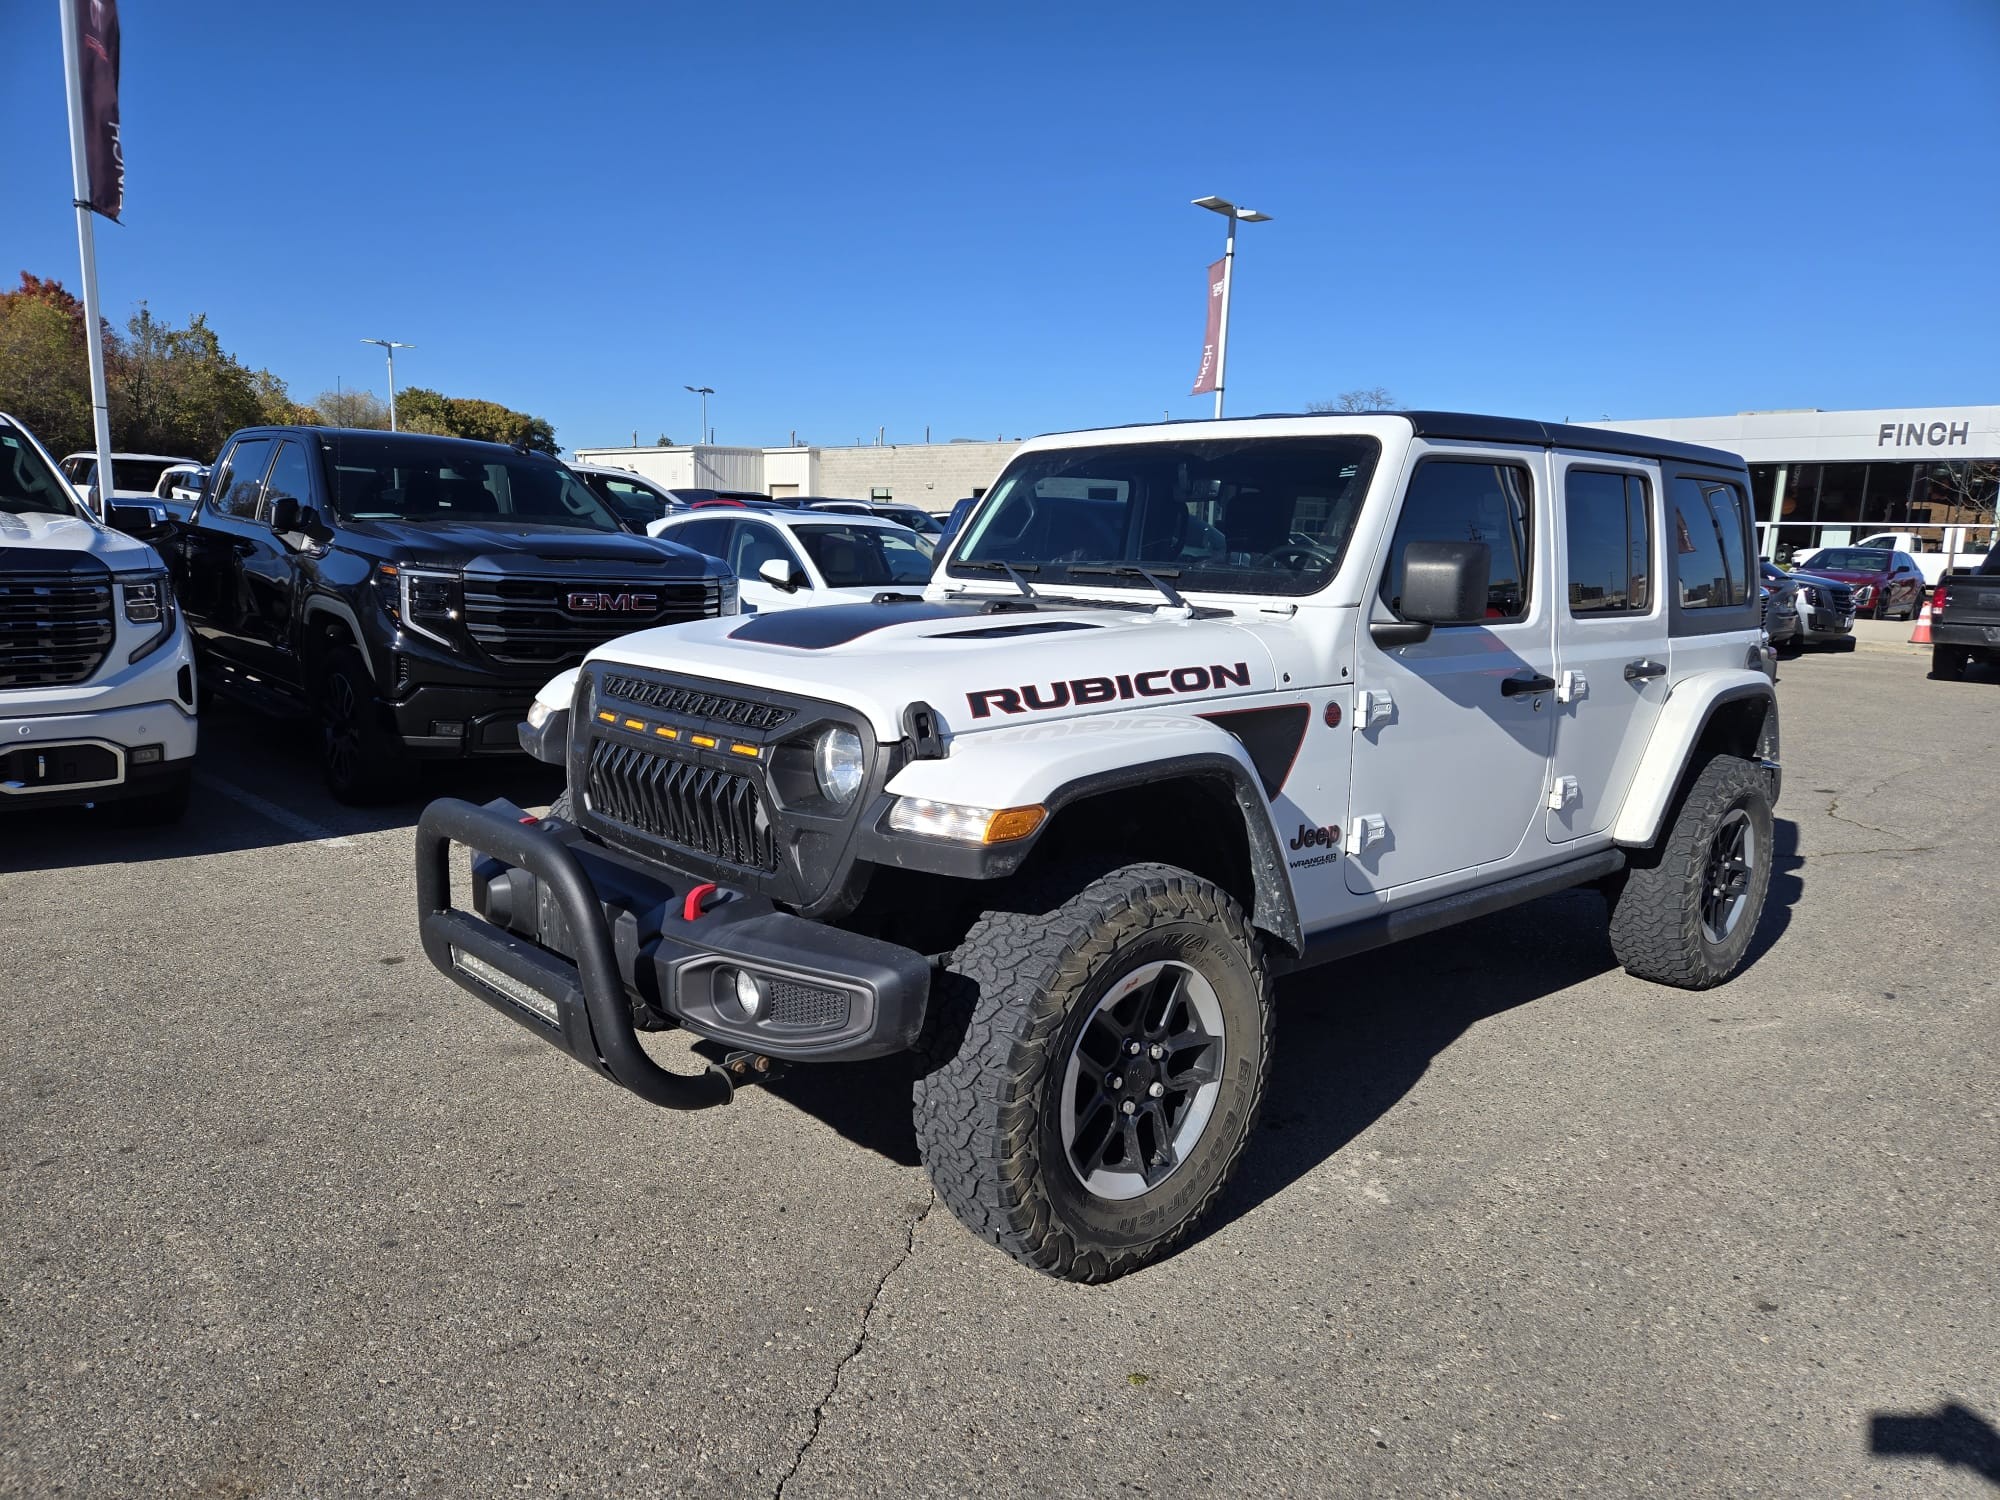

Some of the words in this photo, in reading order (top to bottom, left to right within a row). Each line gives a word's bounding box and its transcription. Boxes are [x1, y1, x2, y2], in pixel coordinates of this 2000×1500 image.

[1878, 421, 1969, 447] FINCH
[567, 592, 658, 611] GMC
[966, 662, 1251, 719] RUBICON
[1290, 824, 1341, 850] Jeep
[1289, 853, 1337, 869] WRANGLER
[1162, 932, 1209, 953] T/A
[1117, 1057, 1252, 1235] BFGoodrich
